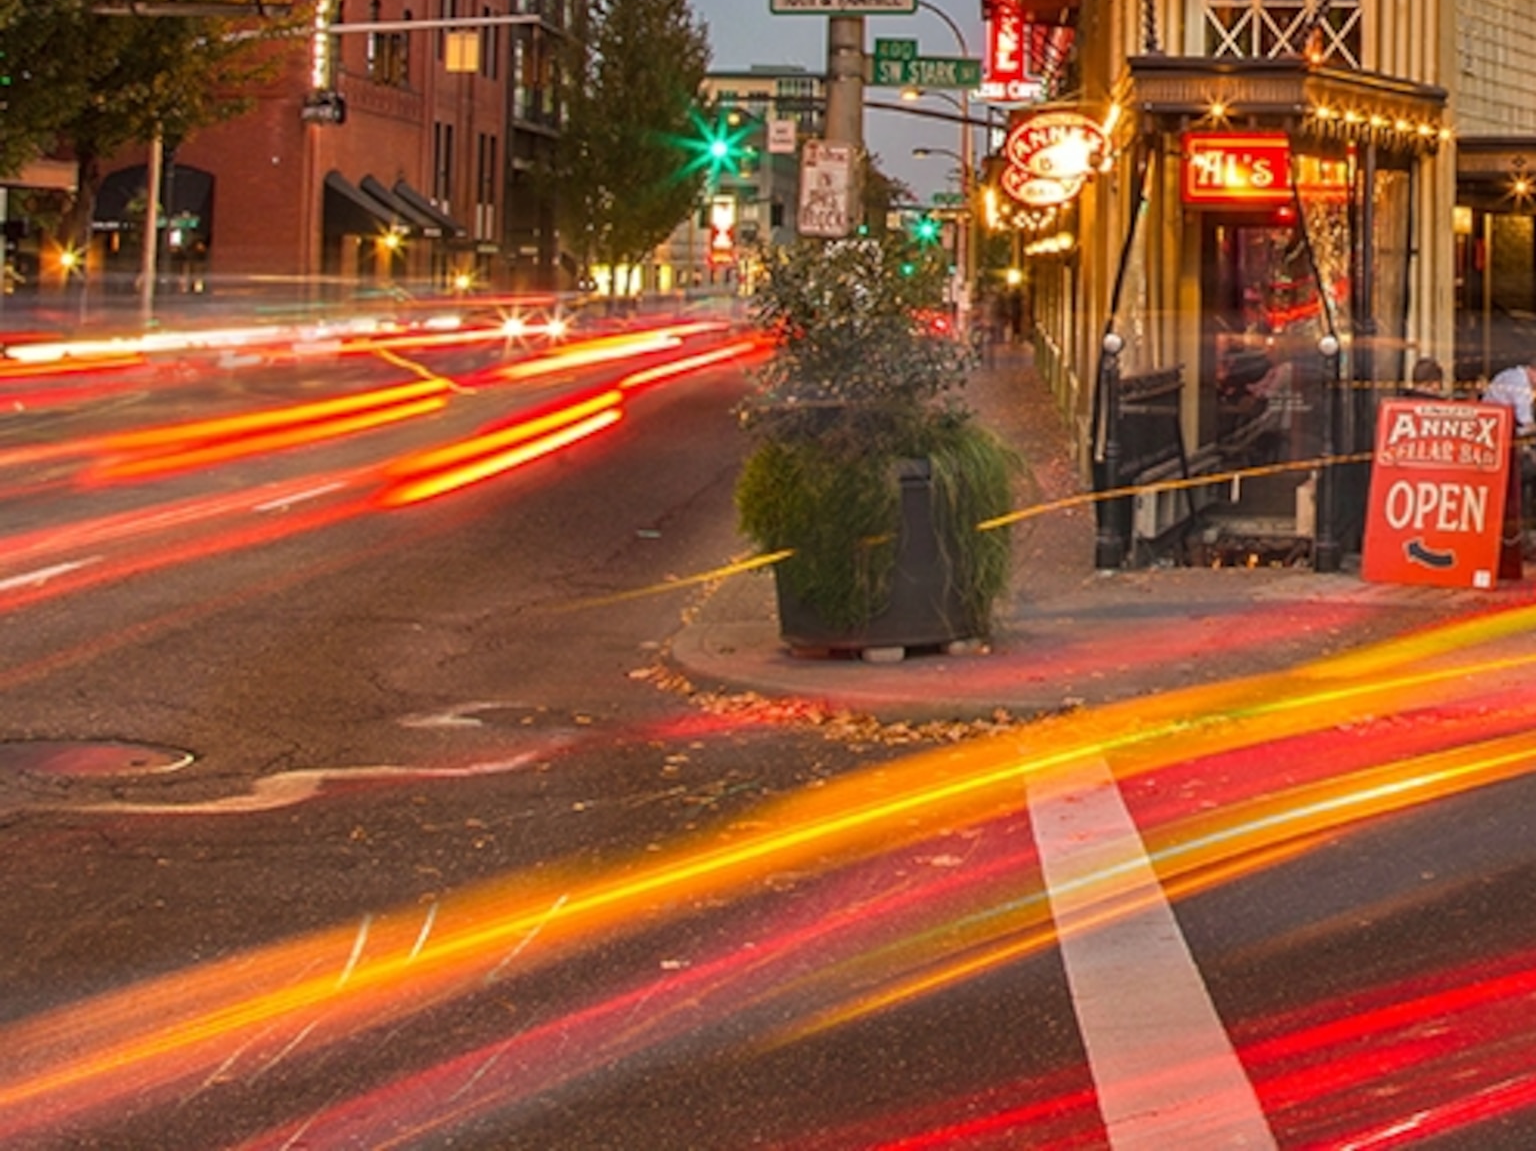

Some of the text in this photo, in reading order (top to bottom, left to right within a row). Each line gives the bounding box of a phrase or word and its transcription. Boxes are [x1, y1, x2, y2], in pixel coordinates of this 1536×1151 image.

[907, 61, 958, 85] STARK
[1389, 414, 1497, 449] ANNEX
[1385, 480, 1490, 534] OPEN
